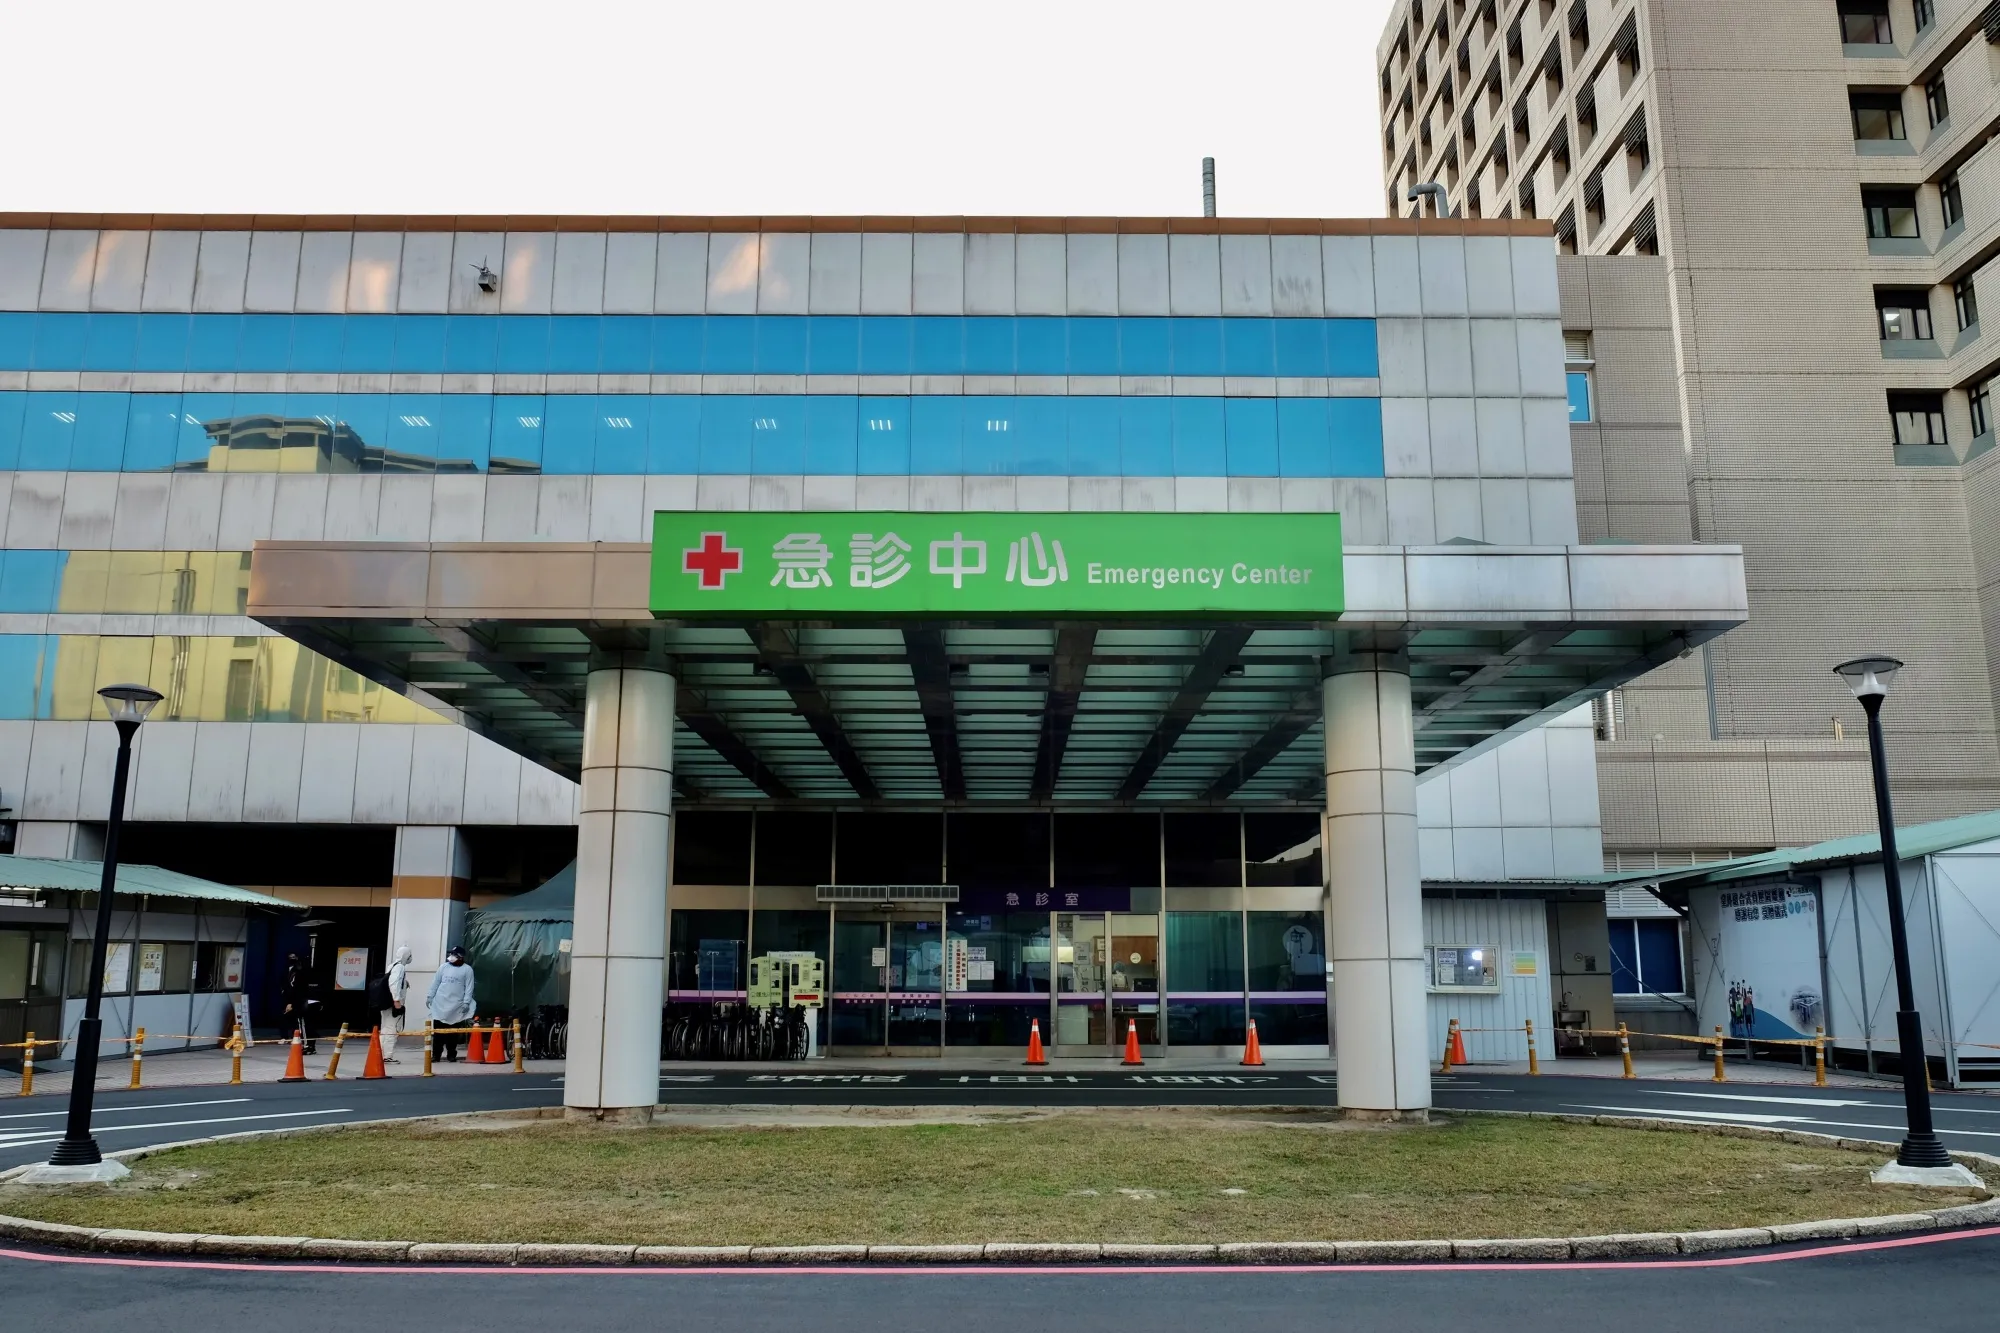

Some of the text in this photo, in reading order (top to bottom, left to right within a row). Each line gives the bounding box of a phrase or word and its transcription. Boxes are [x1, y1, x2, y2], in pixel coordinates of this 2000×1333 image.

[770, 531, 1069, 589] 急診中心
[1087, 562, 1314, 590] Emergency Center
[1006, 892, 1079, 906] 急診室
